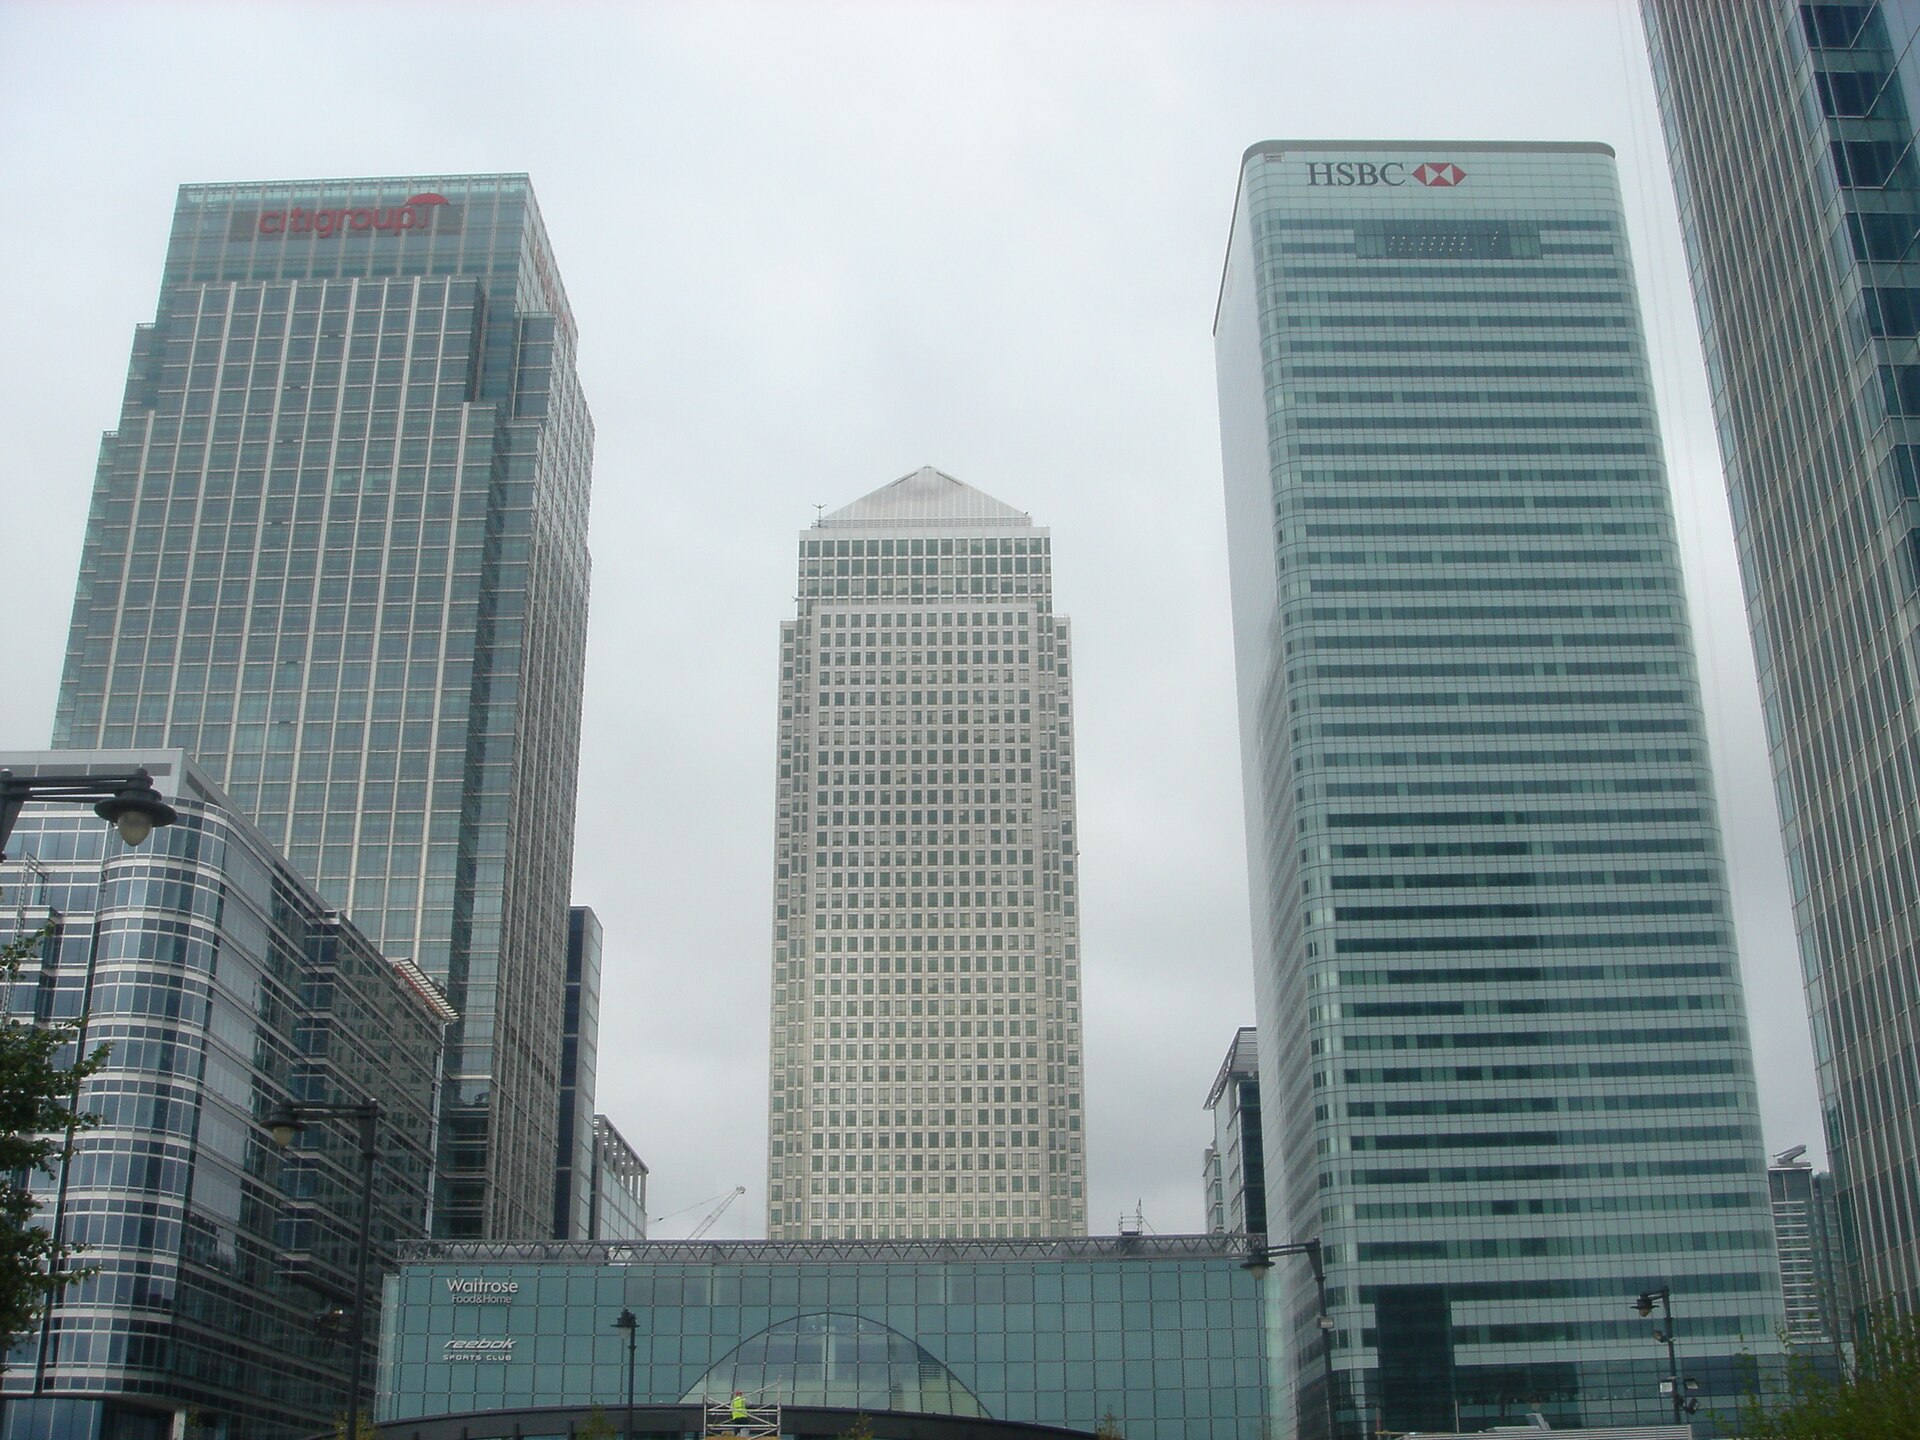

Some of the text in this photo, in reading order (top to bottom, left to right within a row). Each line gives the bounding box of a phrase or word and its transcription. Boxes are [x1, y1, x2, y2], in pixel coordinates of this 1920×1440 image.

[1305, 162, 1406, 187] HSBC
[259, 206, 416, 238] citigroup
[446, 1278, 518, 1293] Waitrose
[451, 1294, 512, 1304] Food&Home
[444, 1338, 517, 1349] reebok
